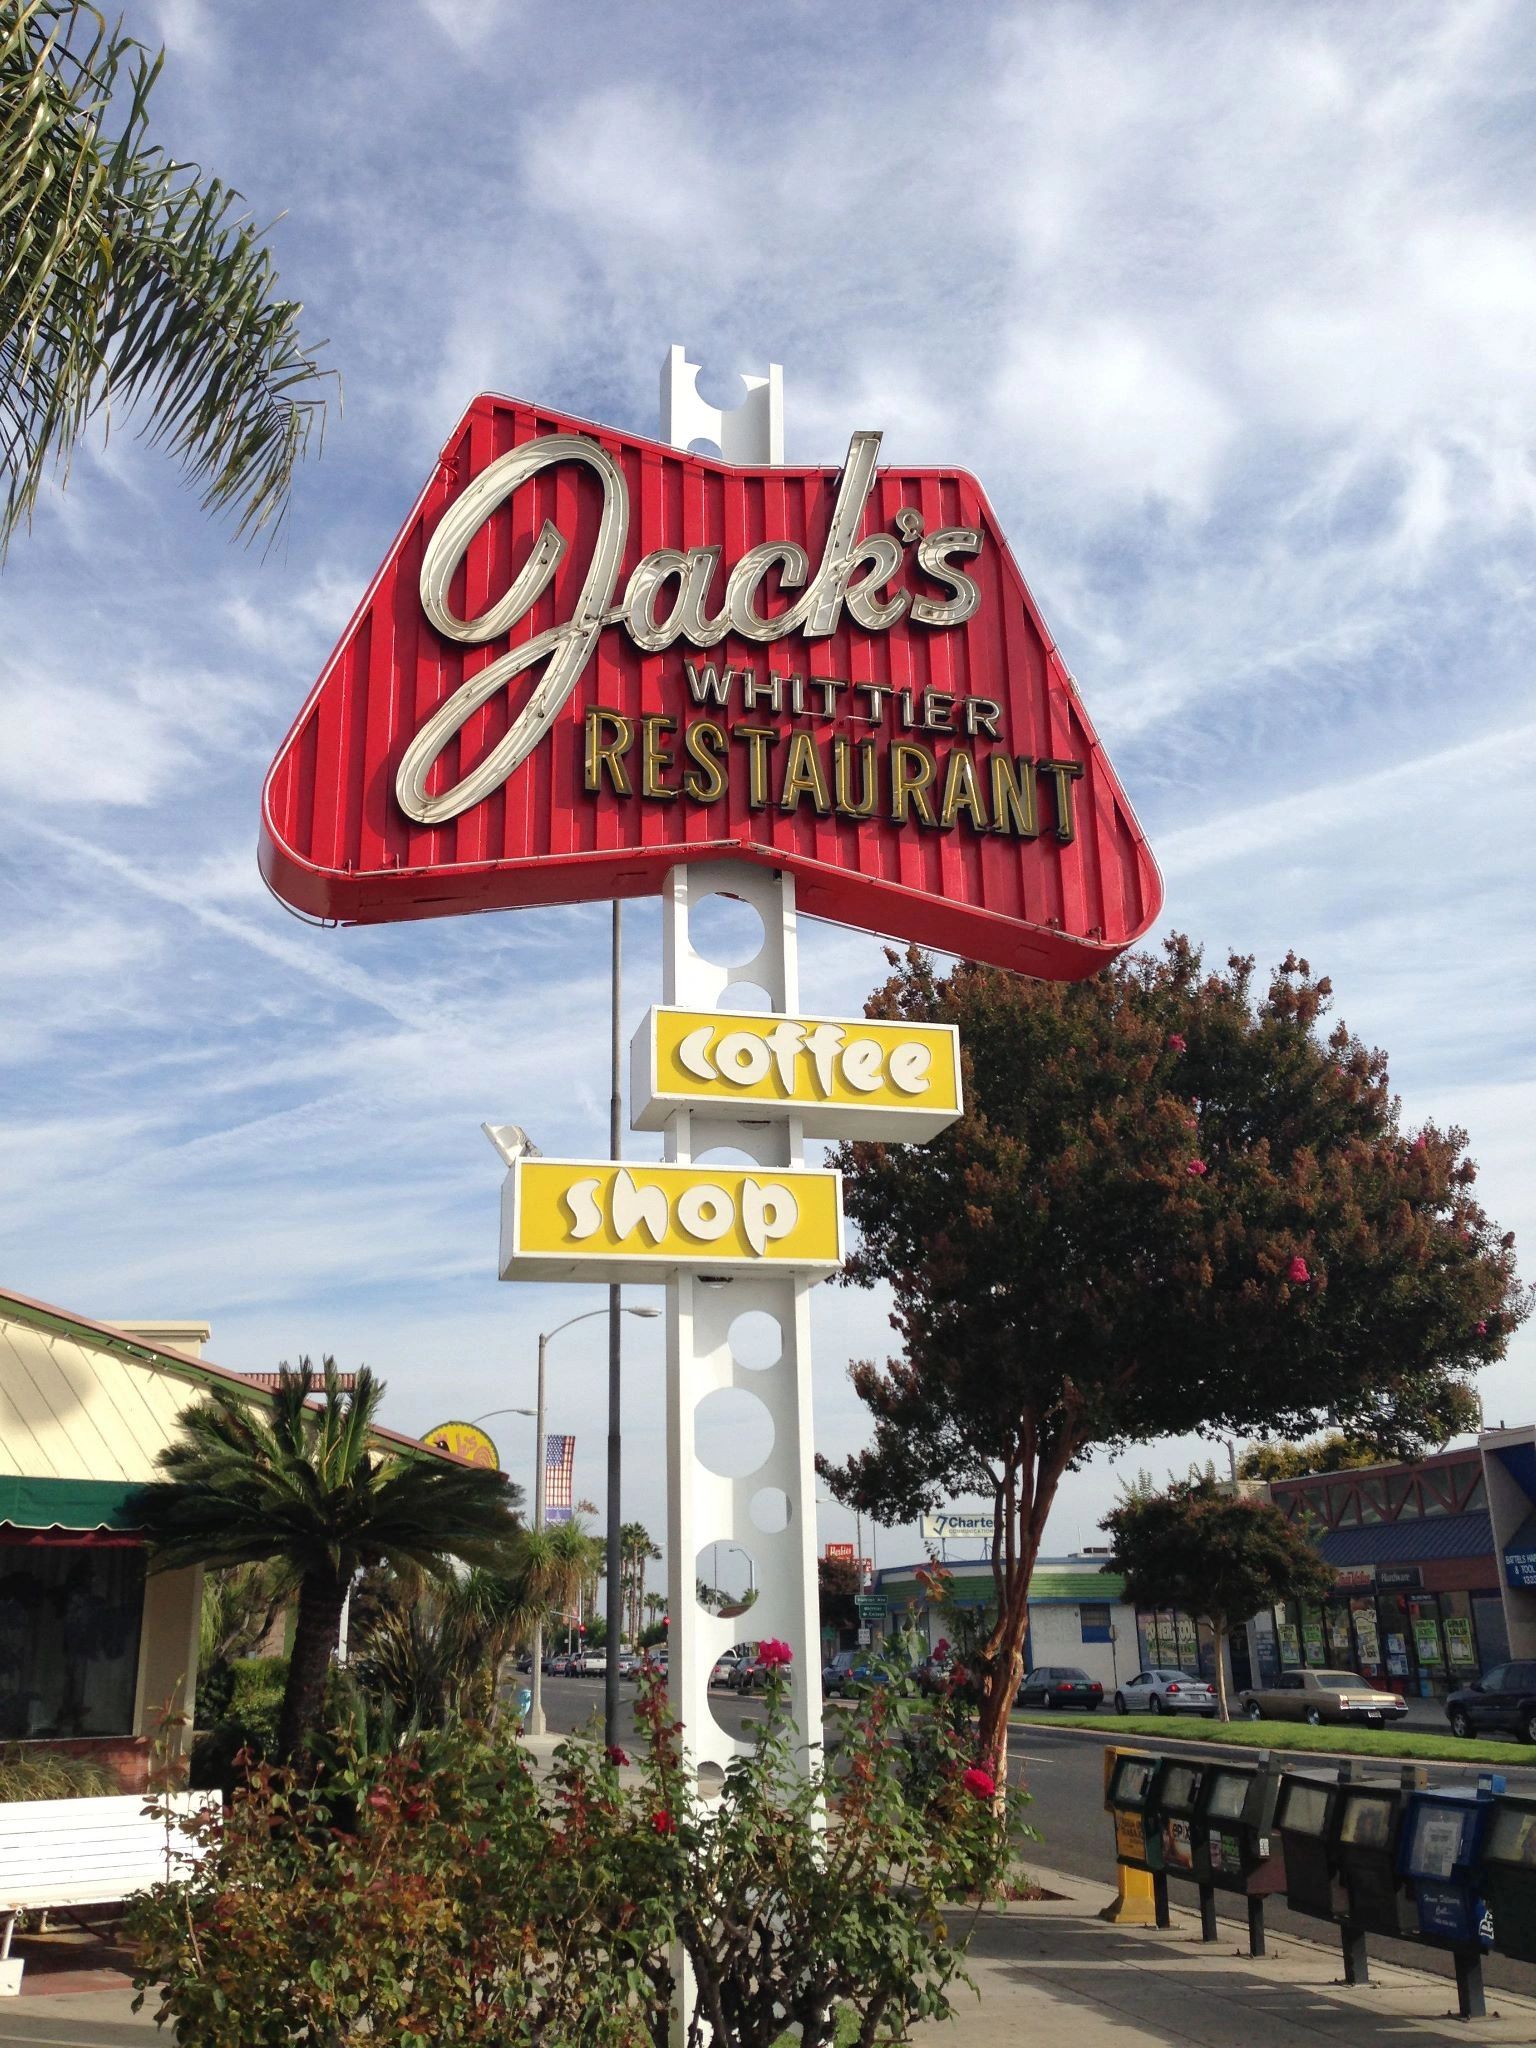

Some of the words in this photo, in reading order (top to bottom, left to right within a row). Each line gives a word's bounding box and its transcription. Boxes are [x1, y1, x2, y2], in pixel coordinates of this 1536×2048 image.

[397, 430, 985, 825] Jack's
[685, 659, 1003, 741] WHITTIER
[584, 705, 1084, 844] RESTAURANT
[679, 1021, 933, 1097] coffee
[566, 1168, 799, 1257] shop
[948, 1516, 994, 1528] Charte
